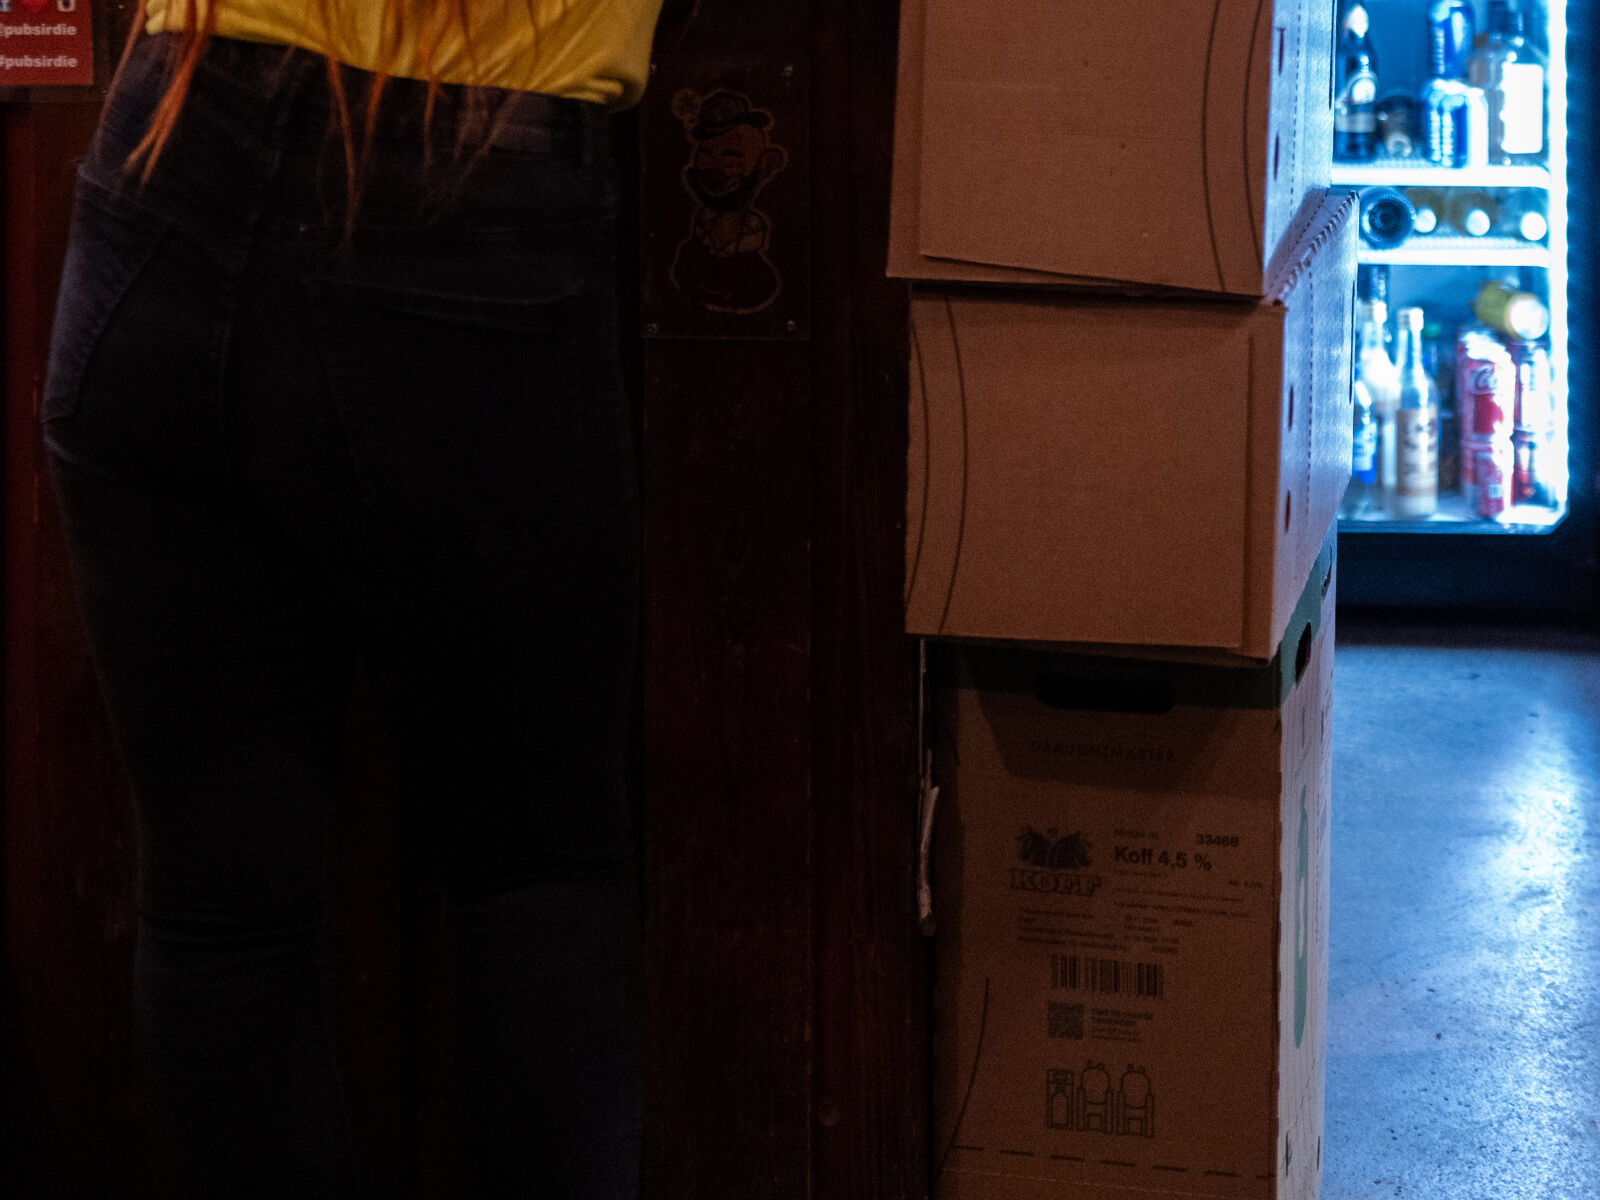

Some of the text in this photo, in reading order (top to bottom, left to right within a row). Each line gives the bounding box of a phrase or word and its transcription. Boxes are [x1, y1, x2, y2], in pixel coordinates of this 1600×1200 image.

[1113, 845, 1213, 872] Koff 4,5 %
[1010, 868, 1102, 897] KOFF
